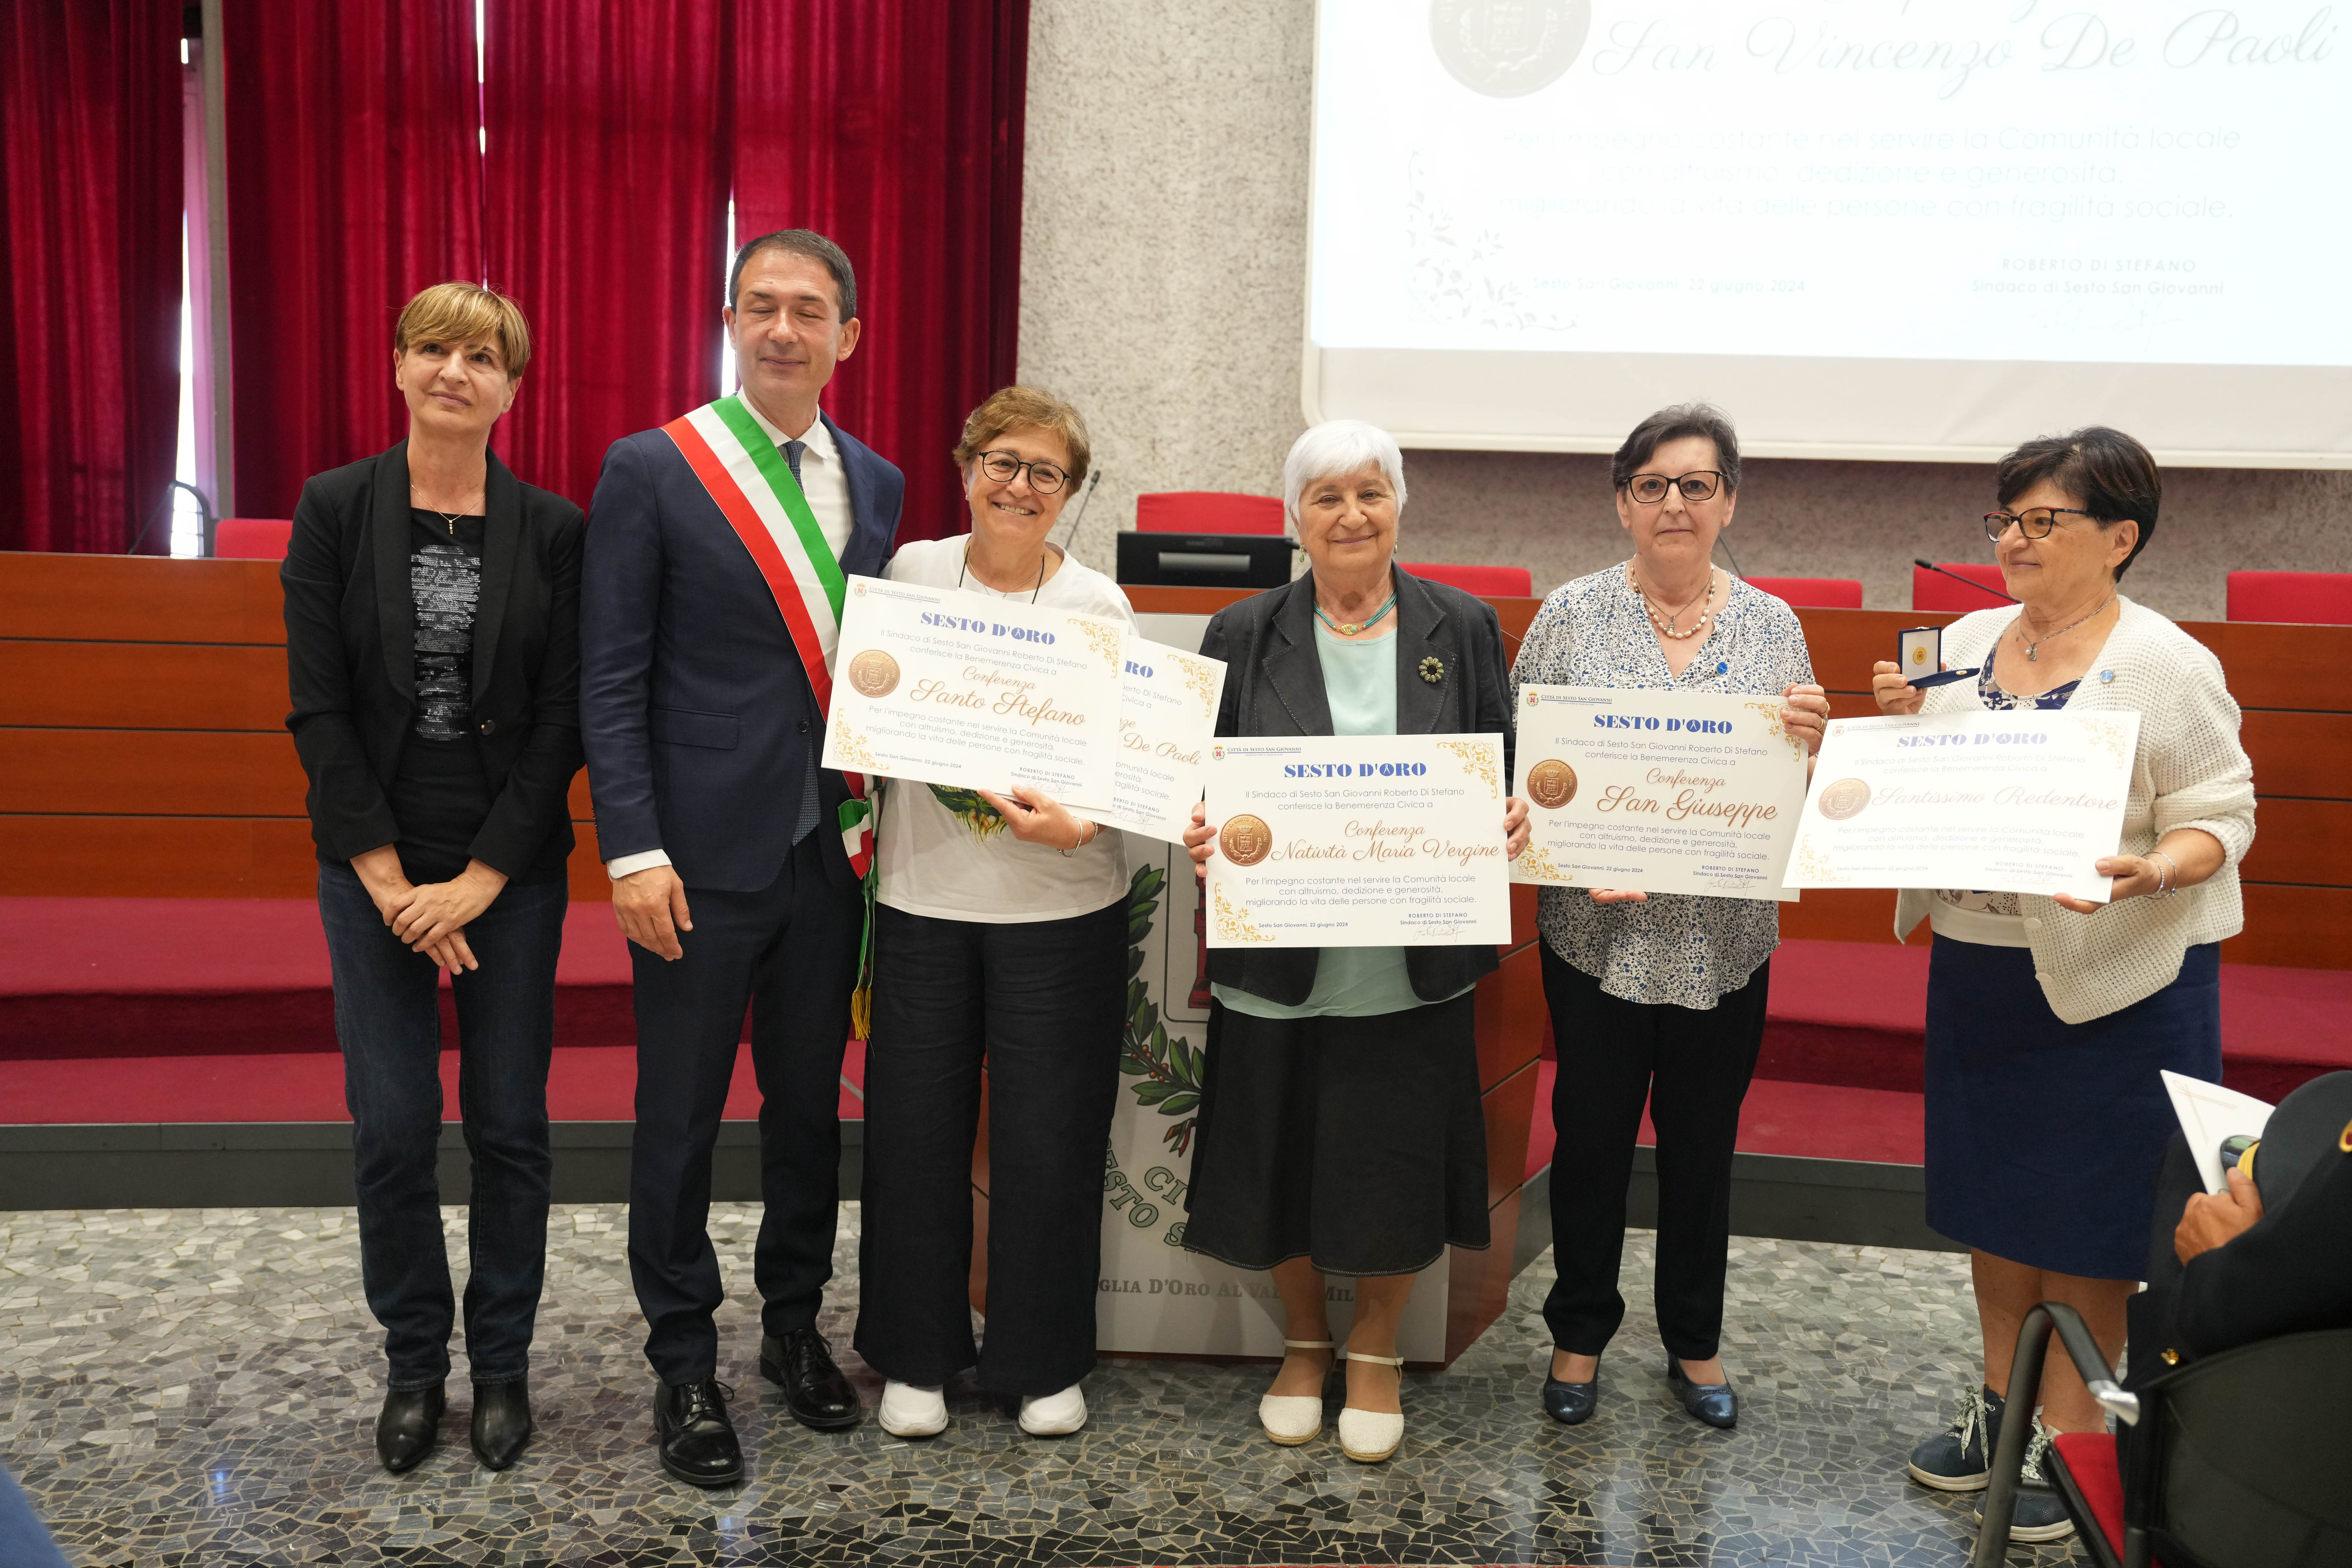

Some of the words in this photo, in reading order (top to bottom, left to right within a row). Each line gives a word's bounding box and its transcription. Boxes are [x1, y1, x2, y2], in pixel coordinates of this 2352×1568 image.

[1592, 19, 1719, 75] San
[1746, 16, 2012, 101] Vincenzo
[2040, 12, 2139, 71] De
[2163, 5, 2338, 69] Paoli
[1998, 126, 2140, 150] Comunità
[2150, 127, 2241, 150] locale
[2001, 258, 2082, 271] ROBERTO
[2090, 259, 2107, 271] DI
[2115, 259, 2196, 273] STEFANO
[1972, 279, 2037, 293] Sindaco
[2044, 280, 2058, 293] di
[2063, 280, 2105, 294] Sesto
[2112, 281, 2141, 294] San
[2148, 282, 2223, 295] Giovanni
[920, 612, 986, 633] SESTO
[991, 623, 1055, 645] D'ORO
[963, 666, 1035, 694] Conferenza
[911, 679, 985, 708] Santo
[993, 692, 1085, 726] Stefano
[1152, 692, 1182, 706] Stefano
[869, 705, 883, 714] Per
[884, 707, 926, 720] l'impegno
[928, 716, 965, 726] costante
[982, 724, 1008, 733] servire
[1020, 729, 1060, 742] Comunità
[1062, 736, 1087, 746] locale
[1594, 714, 1660, 730] SESTO
[1666, 718, 1732, 734] D'ORO
[1561, 738, 1595, 746] Sindaco
[1649, 743, 1686, 751] Giovanni
[1689, 744, 1722, 753] Roberto
[1735, 747, 1767, 755] Stefano
[1897, 734, 1967, 748] SESTO
[1974, 733, 2047, 745] D'ORO
[1124, 735, 1150, 751] De
[1157, 743, 1202, 764] Paoli
[1585, 751, 1628, 760] conferisce
[1640, 753, 1698, 764] Benemerenza
[1701, 757, 1727, 765] Civica
[1150, 769, 1174, 782] locale
[1284, 764, 1352, 778] SESTO
[1359, 763, 1426, 777] D'ORO
[1646, 768, 1726, 793] Conferenza
[1141, 788, 1170, 801] sociale.
[1343, 789, 1381, 797] Giovanni
[1870, 787, 1986, 805] Santissimo
[1994, 787, 2119, 810] Redentore
[1137, 803, 1159, 813] STEFANO
[1597, 786, 1660, 813] San
[1666, 789, 1779, 828] Giuseppe
[1145, 812, 1166, 821] Giovanni
[1345, 821, 1424, 842] Conferenza
[1271, 839, 1346, 859] Natività
[1352, 841, 1415, 861] Maria
[1423, 841, 1500, 865] Vergine
[1262, 877, 1305, 887] l'impegno
[1403, 874, 1446, 883] Comunità
[1395, 885, 1443, 895] generosità,
[1246, 898, 1297, 907] migliorando
[1409, 896, 1441, 905] fragilità
